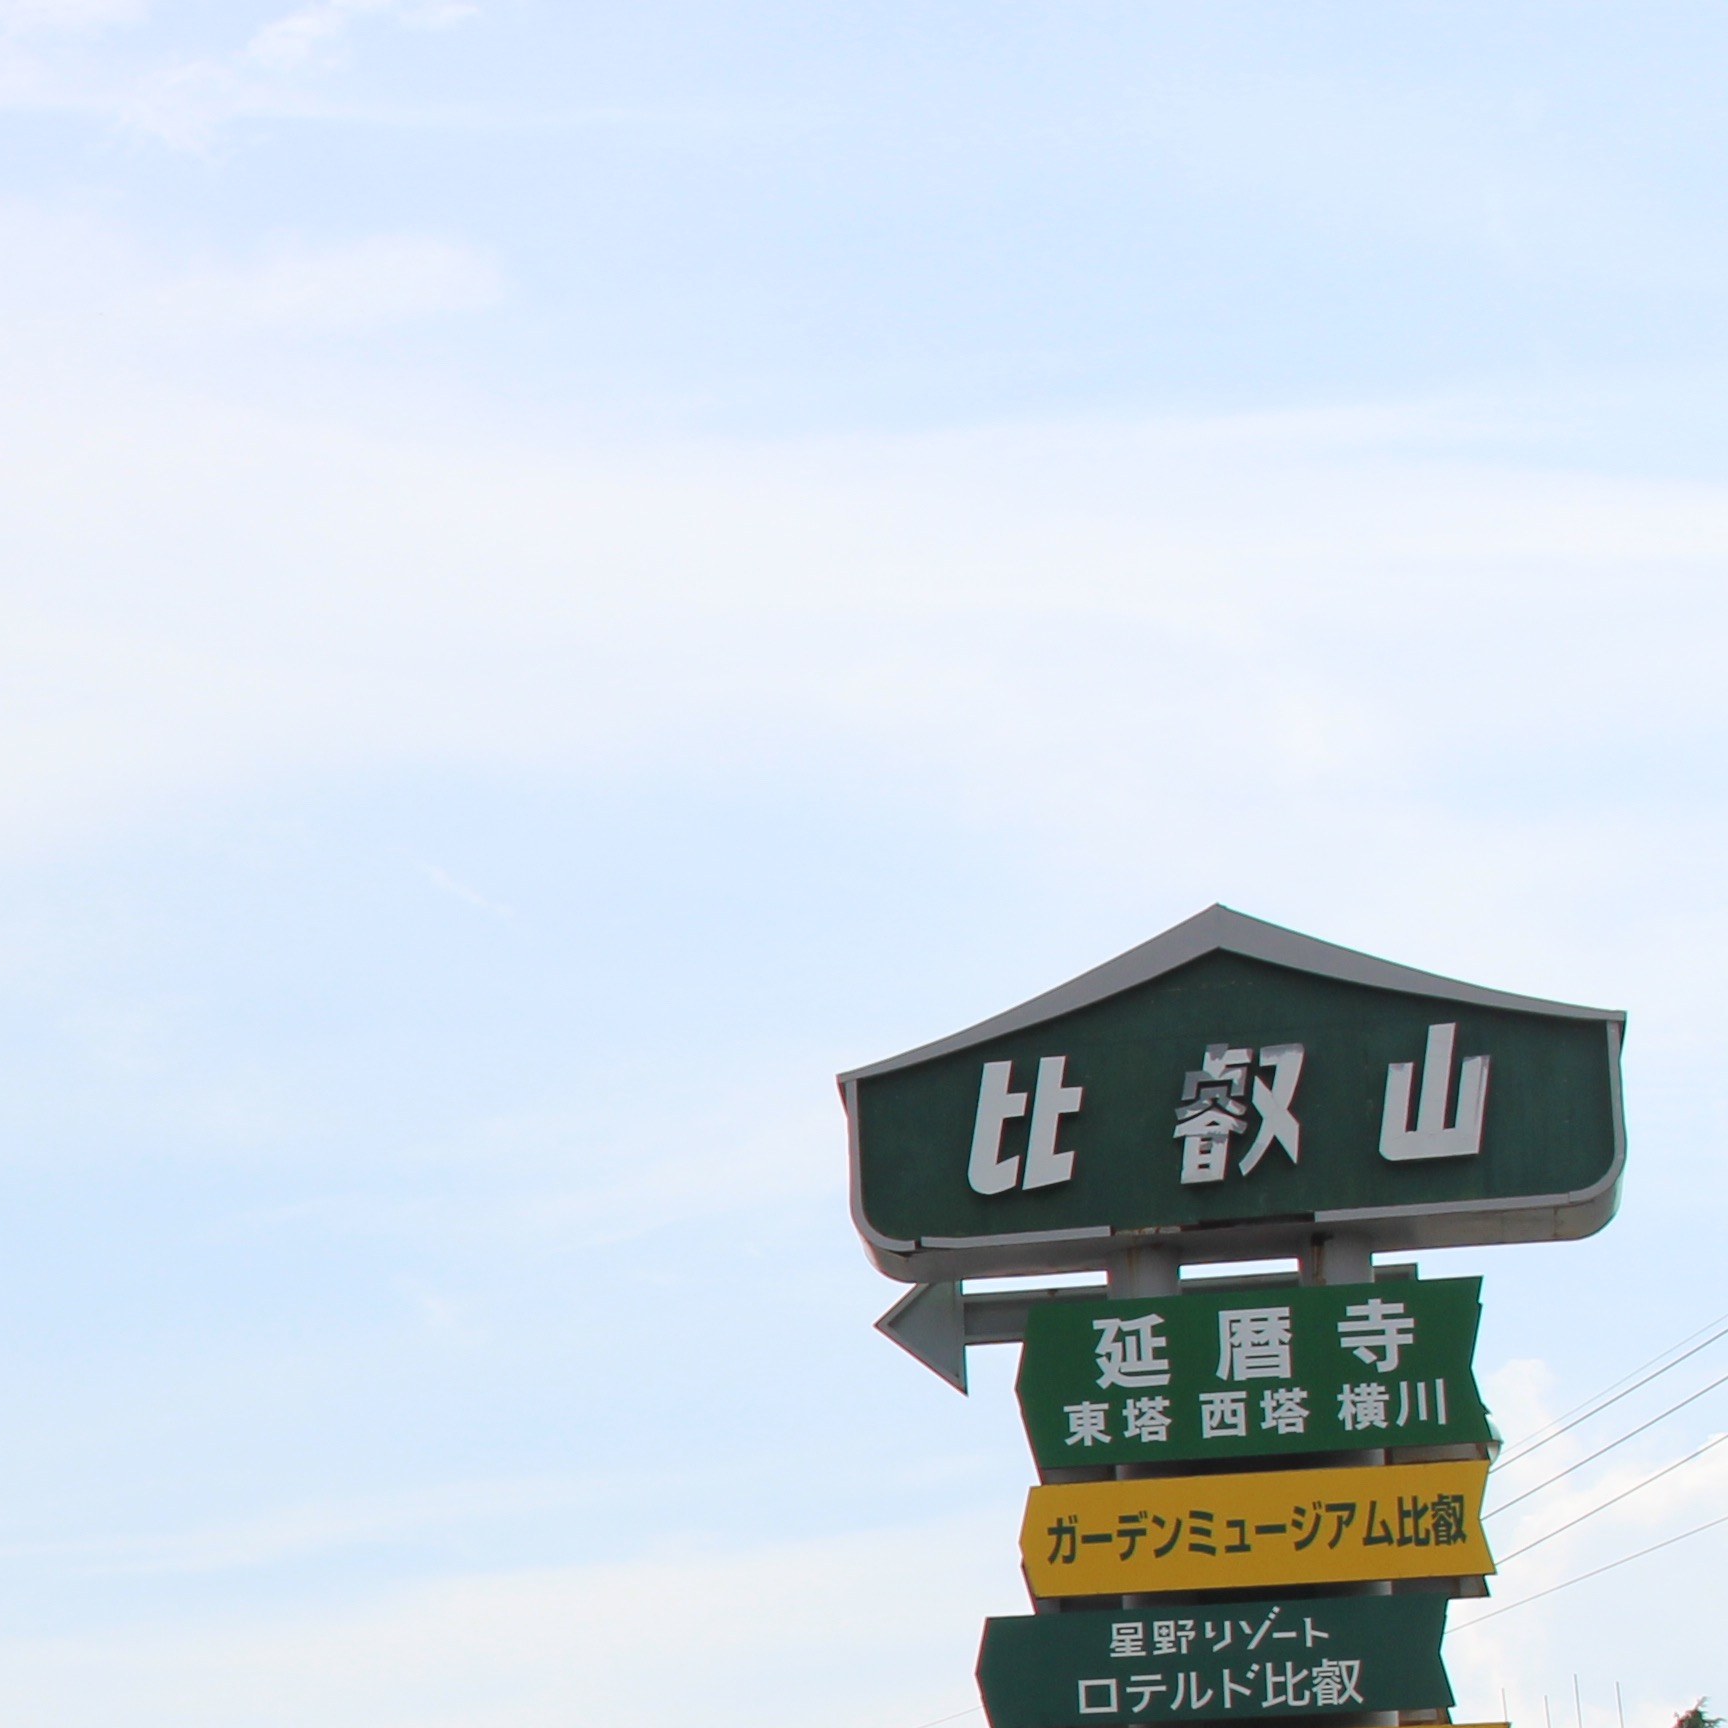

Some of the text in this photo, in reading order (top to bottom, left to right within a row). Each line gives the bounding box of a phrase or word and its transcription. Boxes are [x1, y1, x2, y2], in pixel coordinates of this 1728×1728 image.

[967, 1021, 1494, 1196] 比叡山
[1091, 1297, 1417, 1391] 延暦寺
[1062, 1377, 1448, 1449] 東塔 西塔 横川
[1046, 1492, 1468, 1566] ガーデンミュージアム比叡
[1109, 1605, 1330, 1659] 星野リゾート
[1077, 1658, 1365, 1714] ロテルド比叡
